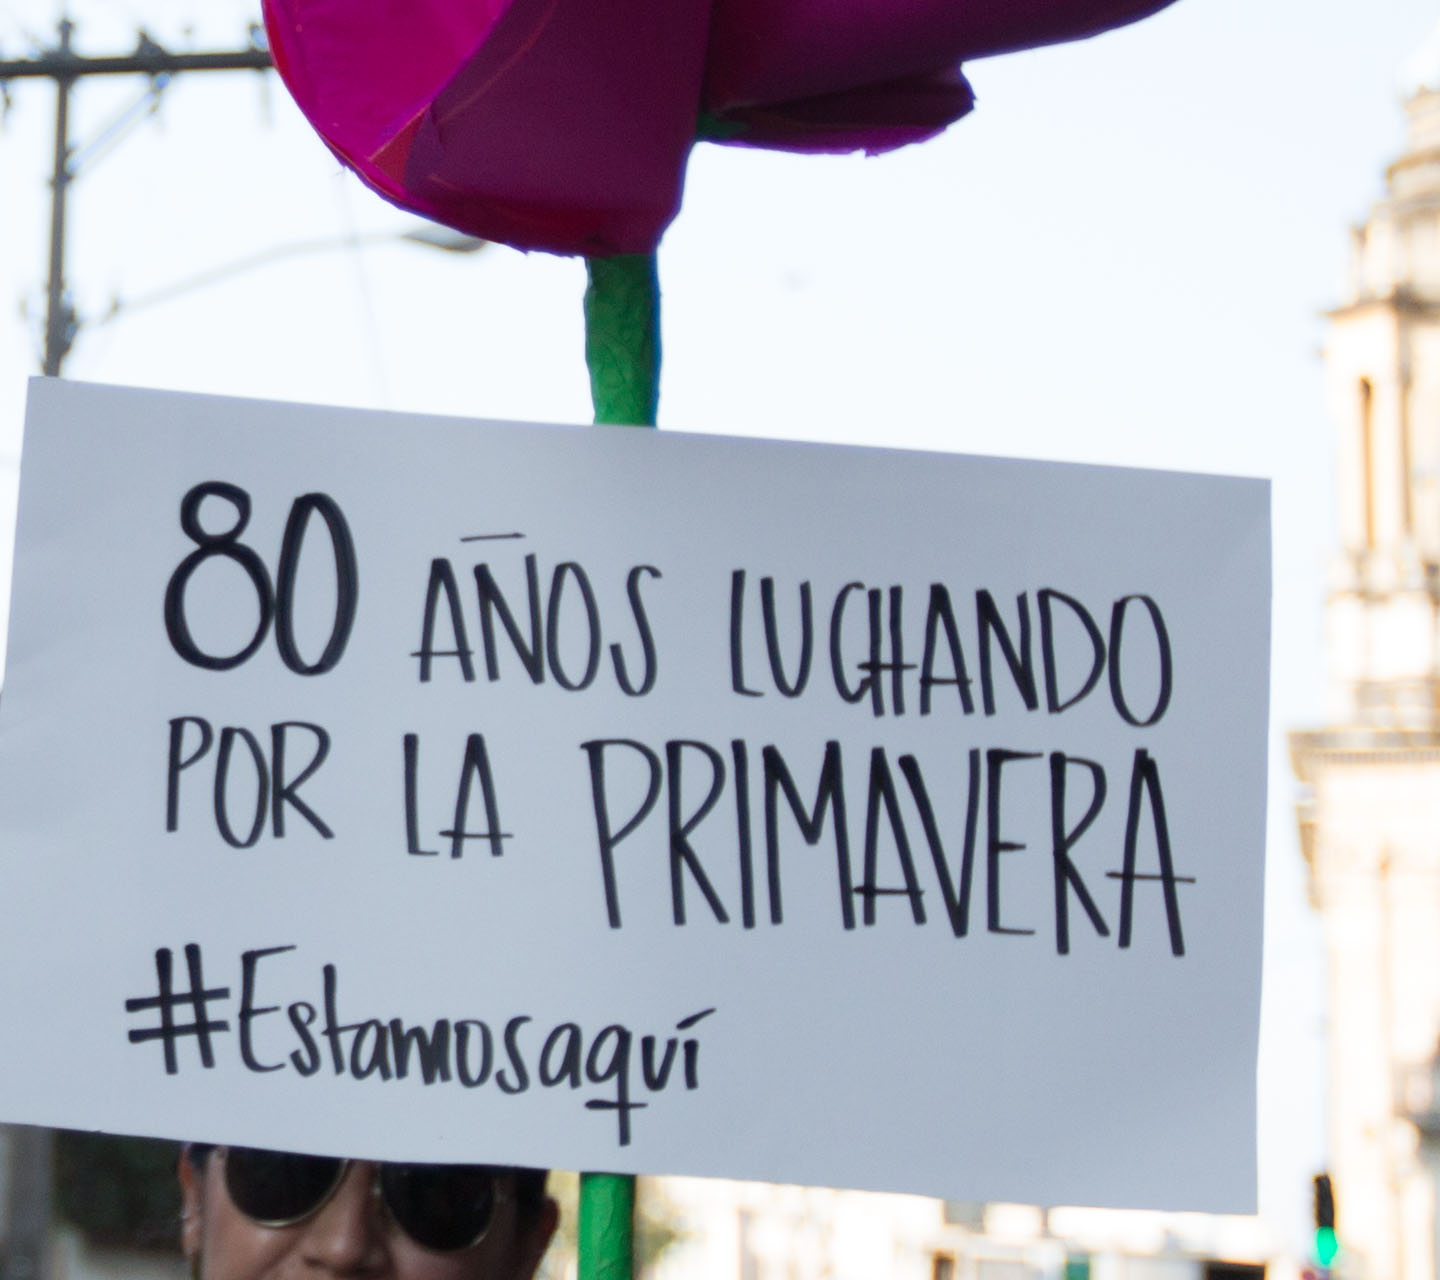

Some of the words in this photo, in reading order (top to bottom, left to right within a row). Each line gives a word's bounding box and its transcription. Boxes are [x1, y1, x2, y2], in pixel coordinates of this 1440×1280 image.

[162, 479, 360, 678] 80
[409, 531, 664, 698] AÑOS
[728, 567, 1174, 729] LUCHANDO
[165, 714, 335, 850] POR
[401, 731, 514, 861] LA
[578, 737, 1197, 959] PRIMAVERA
[123, 942, 717, 1148] #Estamosaquí
